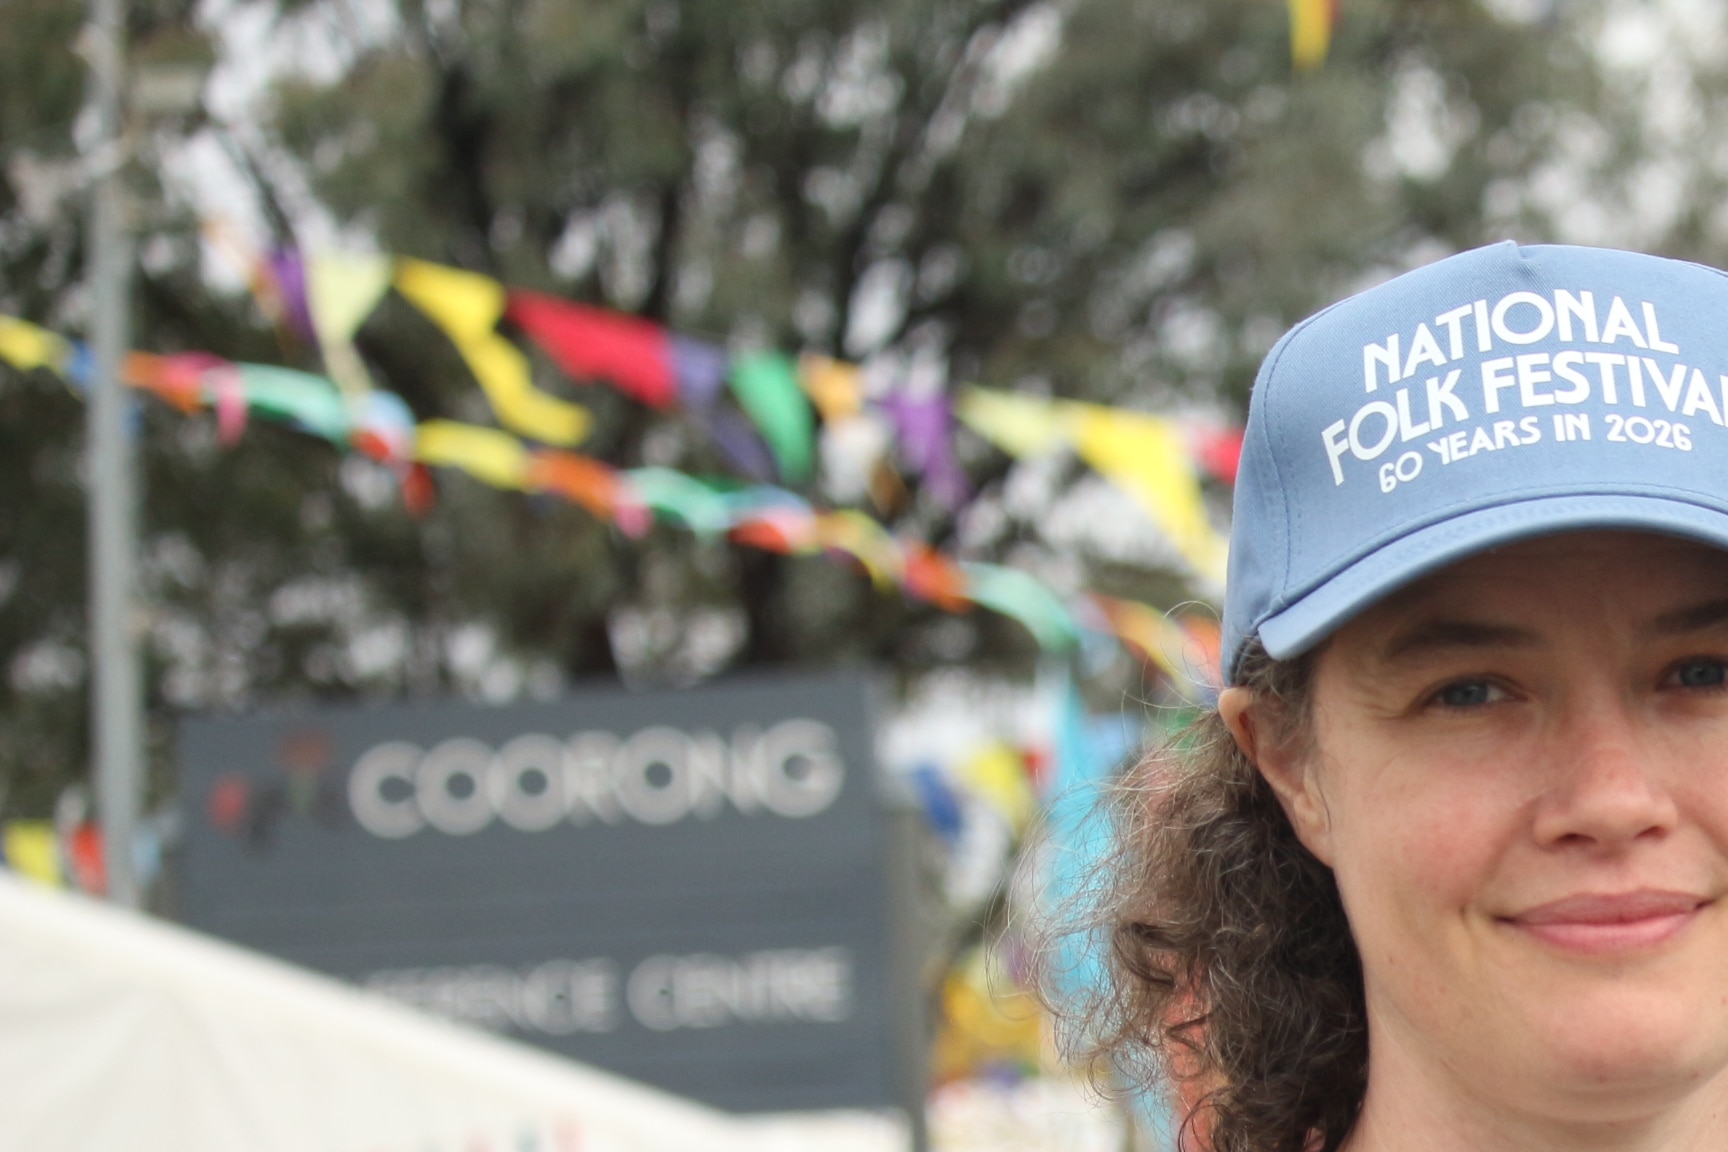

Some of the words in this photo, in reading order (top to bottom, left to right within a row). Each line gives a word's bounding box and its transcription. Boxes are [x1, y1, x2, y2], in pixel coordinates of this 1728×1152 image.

[1364, 289, 1679, 393] NATIONAL
[1321, 370, 1469, 486] FOLK
[1378, 450, 1424, 494] 60
[1428, 416, 1542, 465] YEARS
[1553, 413, 1590, 441] IN
[1604, 414, 1693, 452] 2026
[350, 720, 842, 836] COORONG
